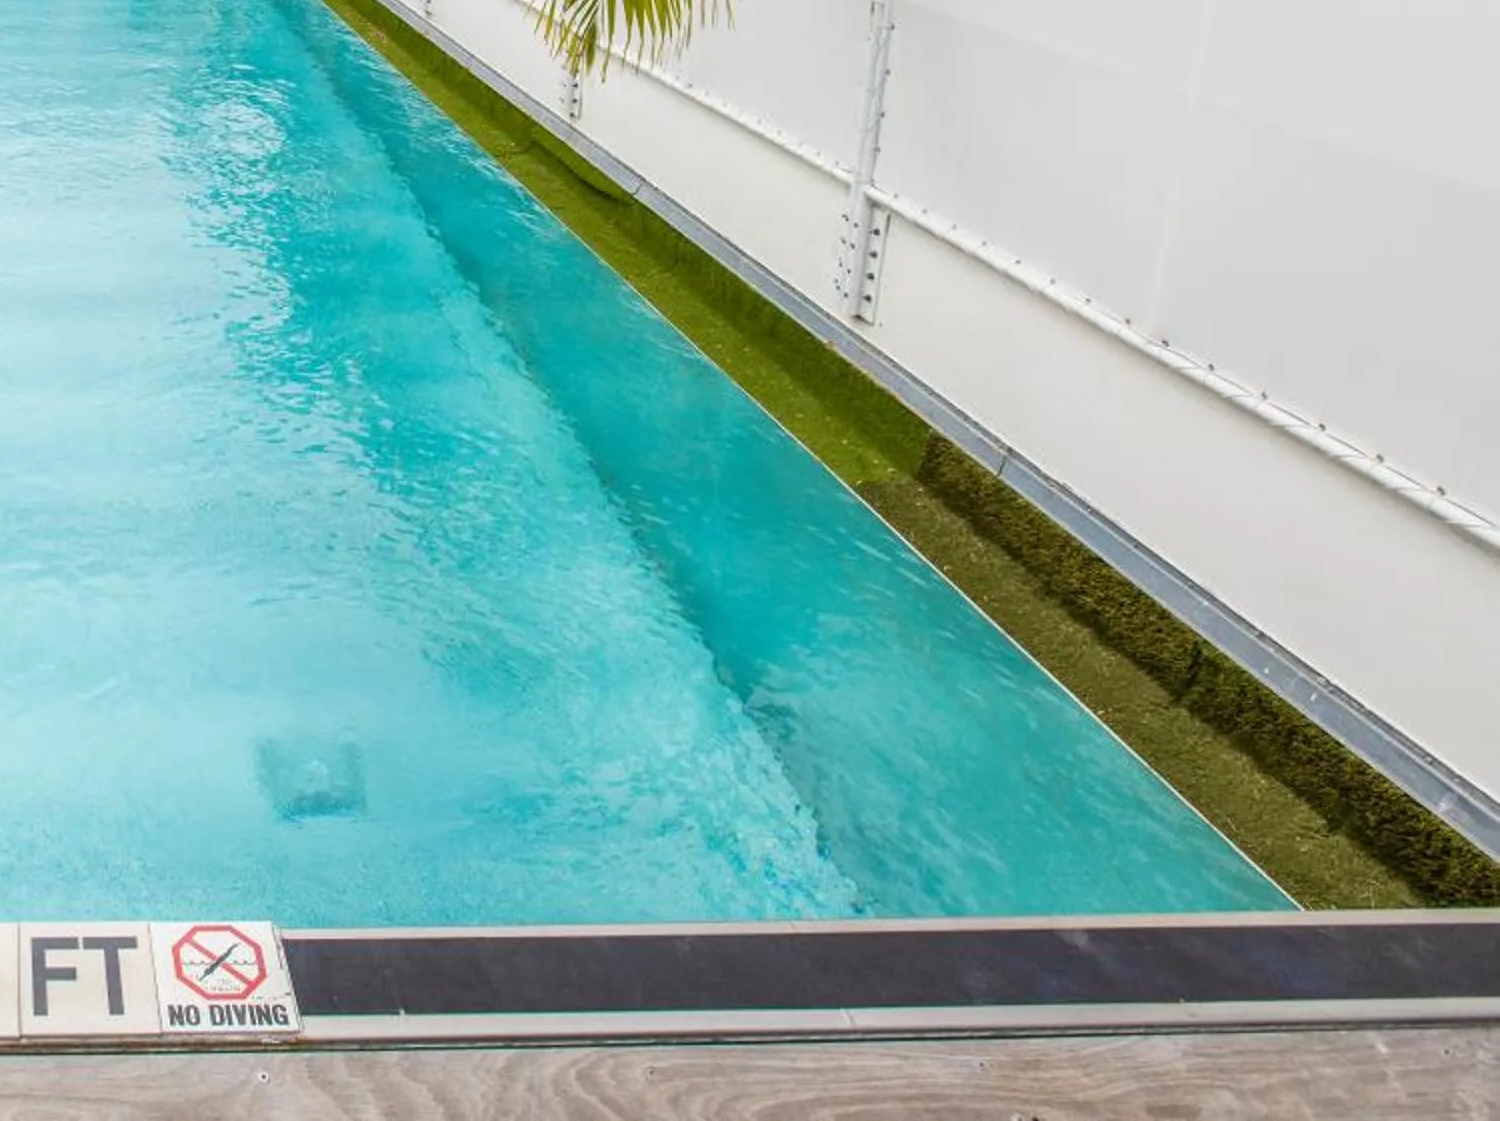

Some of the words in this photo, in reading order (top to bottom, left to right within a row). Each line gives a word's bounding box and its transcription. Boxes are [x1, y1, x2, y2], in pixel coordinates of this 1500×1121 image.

[30, 936, 138, 1017] FT
[167, 1004, 201, 1026] NO
[208, 1003, 290, 1027] DIVING
